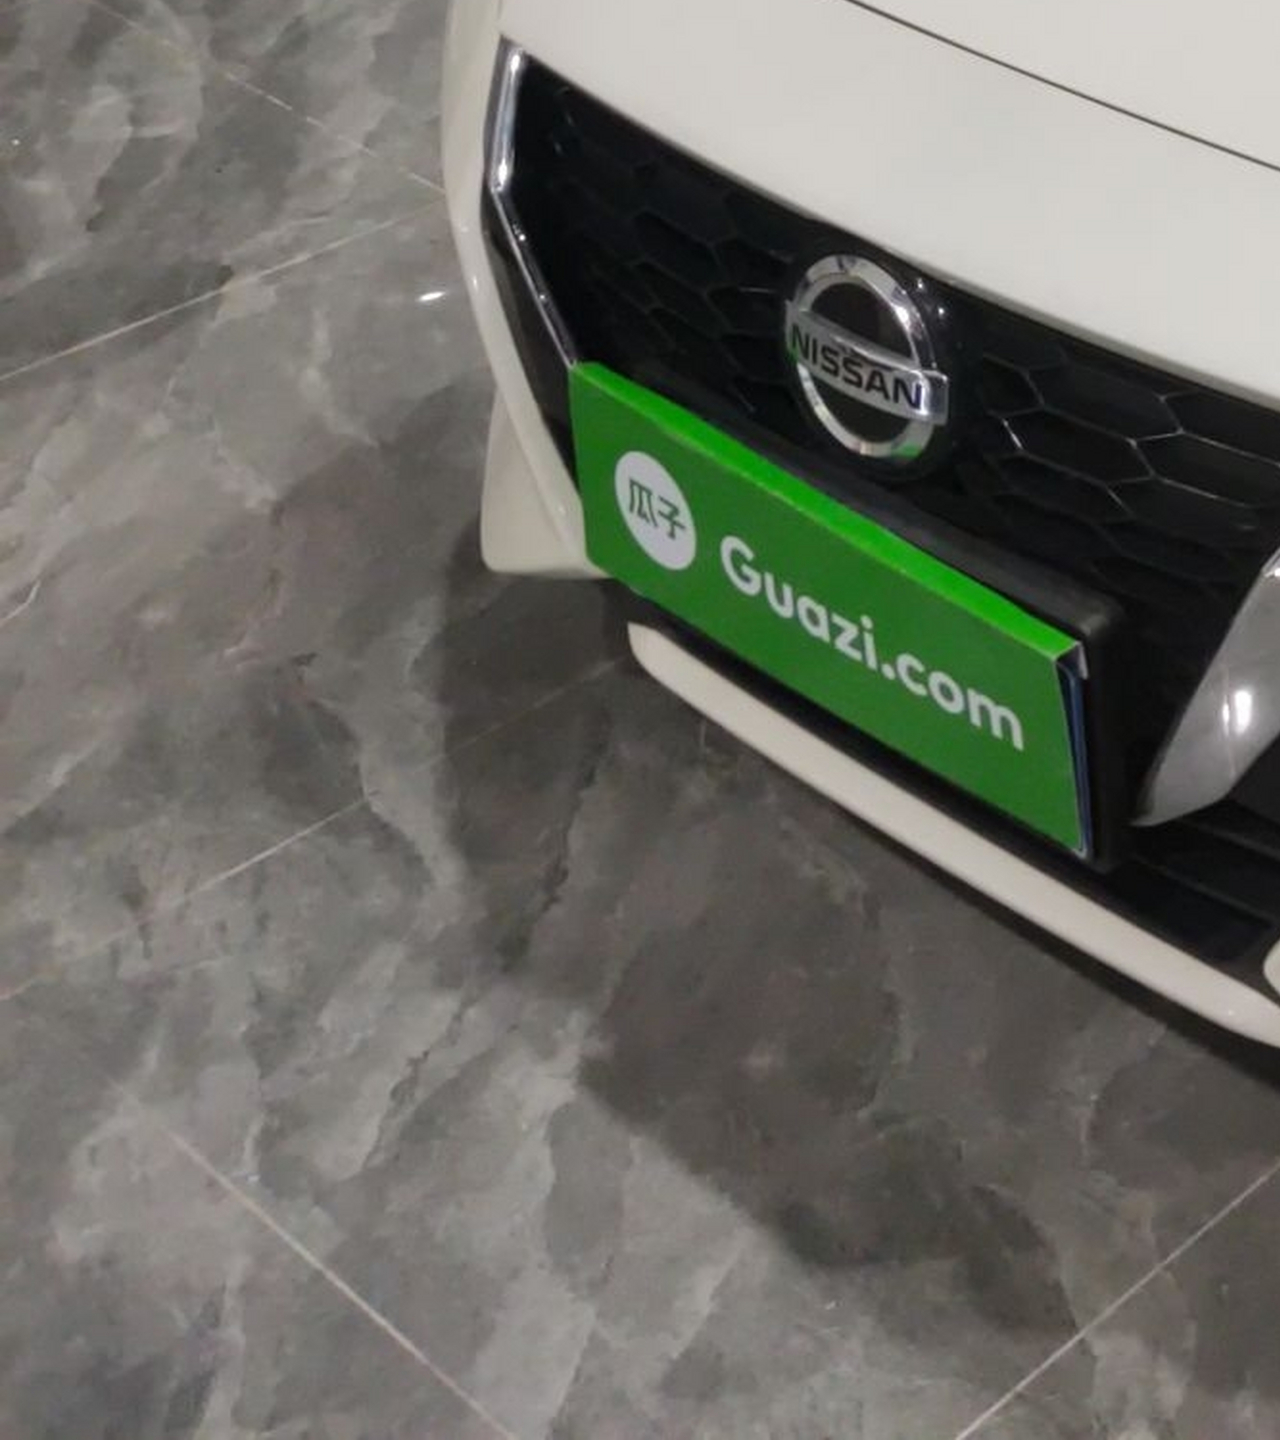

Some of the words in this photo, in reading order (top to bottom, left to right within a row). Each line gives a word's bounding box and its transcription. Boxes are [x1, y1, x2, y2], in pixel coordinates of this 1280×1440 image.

[790, 322, 922, 410] NISSAN
[629, 478, 687, 541] 瓜子
[719, 535, 1024, 751] Guazi.com
